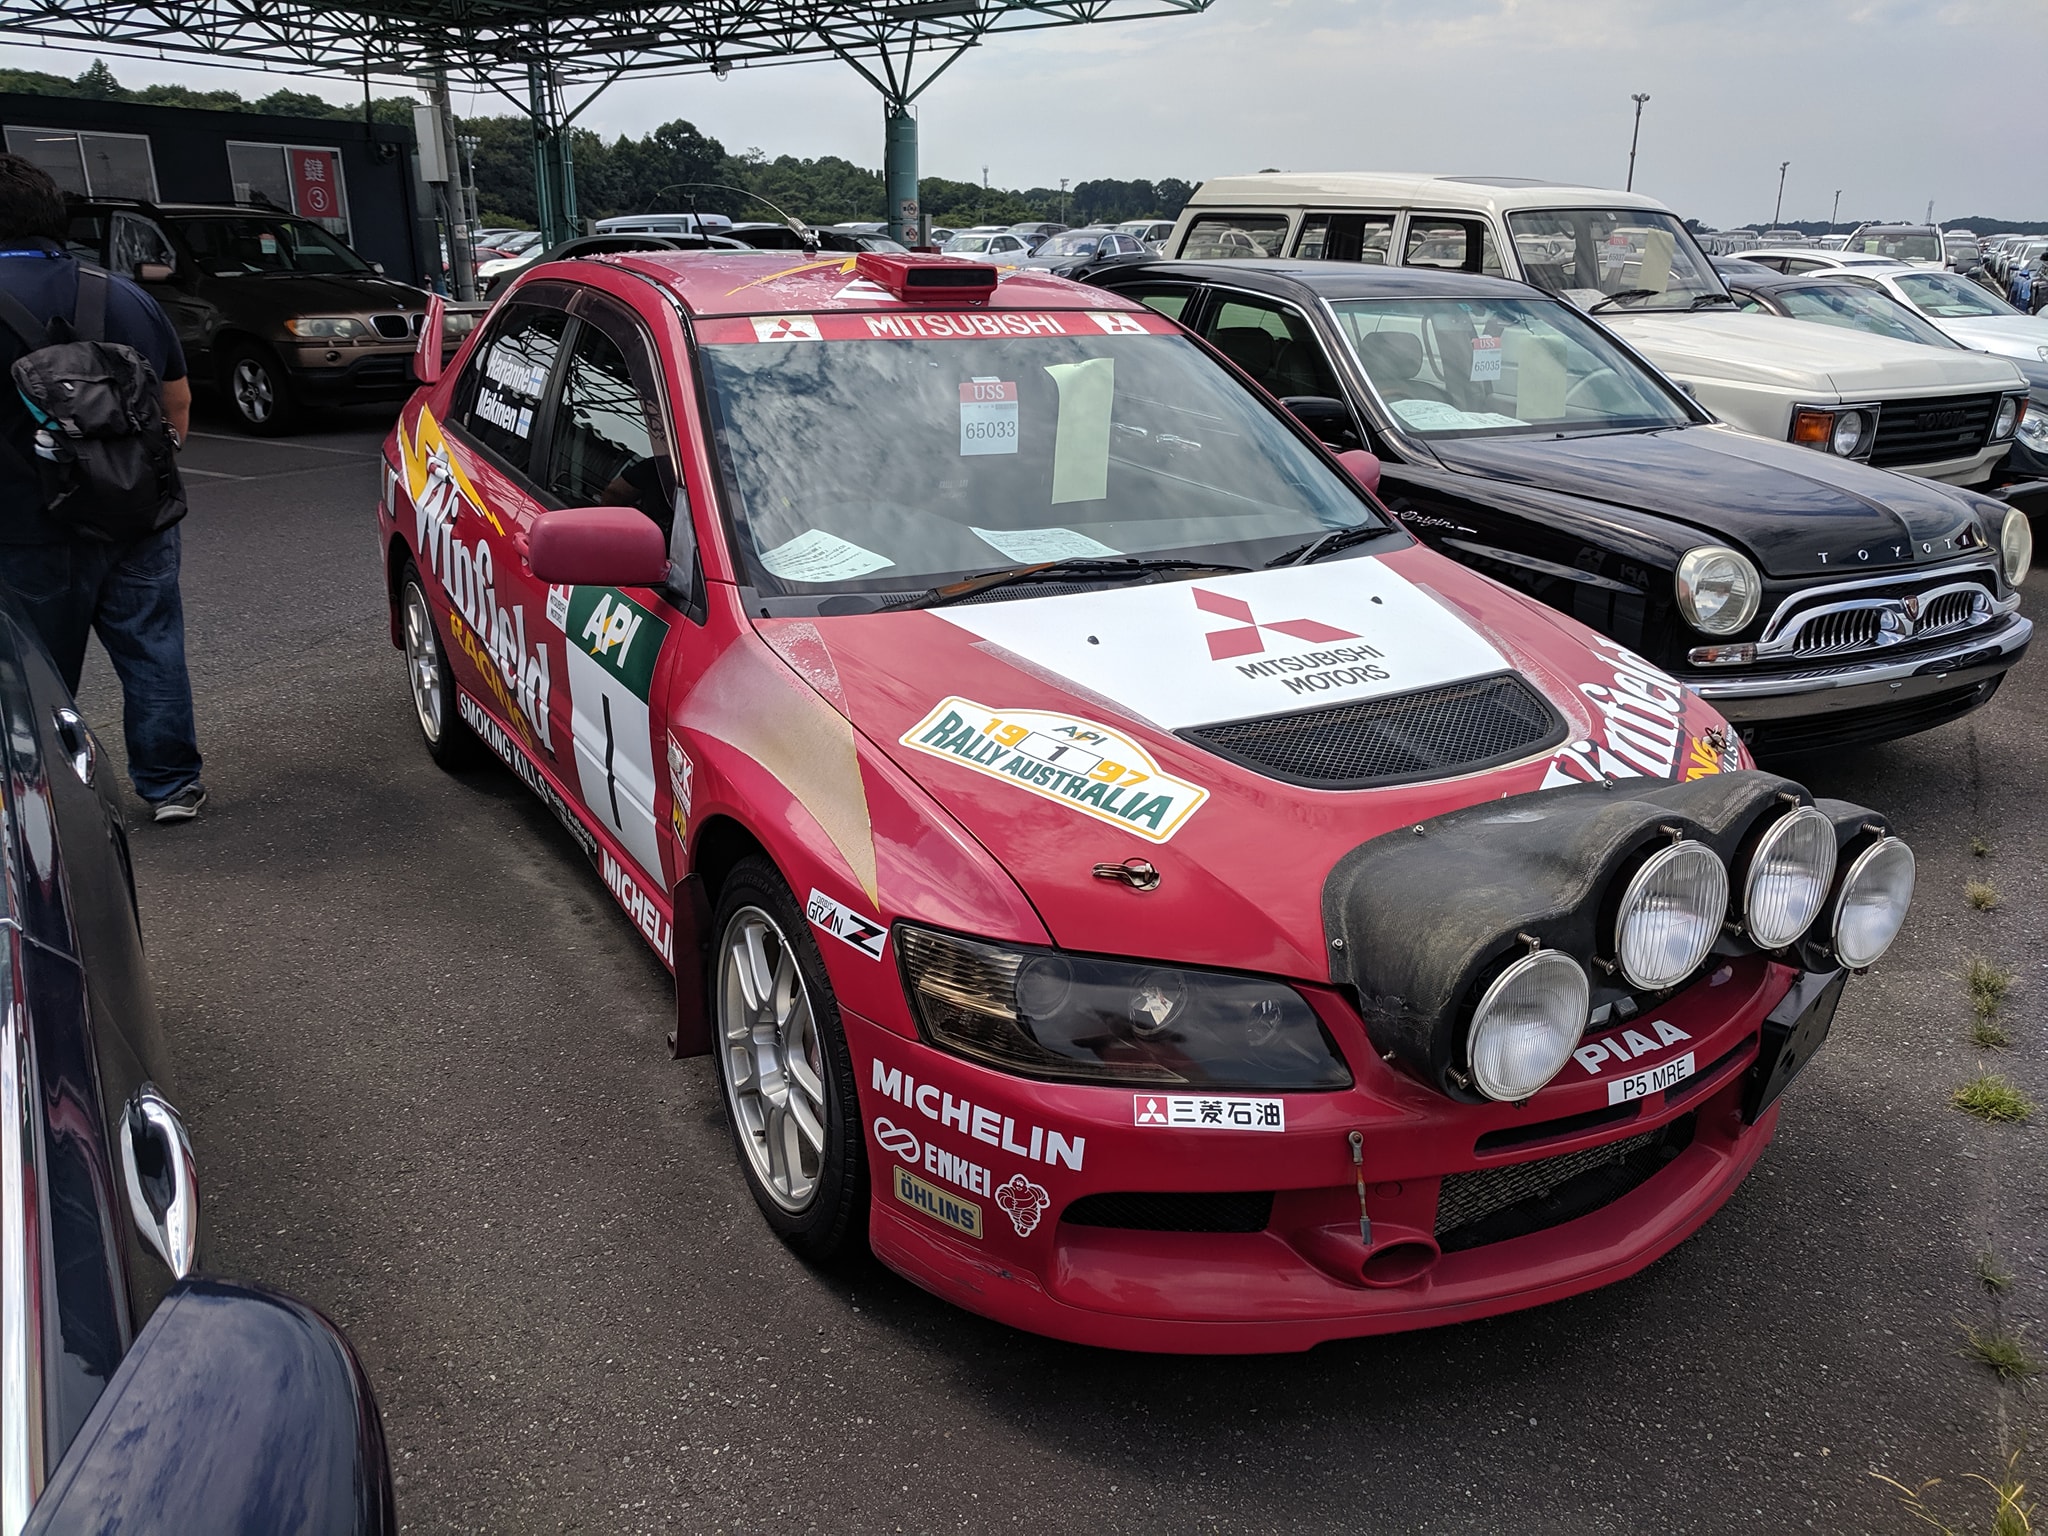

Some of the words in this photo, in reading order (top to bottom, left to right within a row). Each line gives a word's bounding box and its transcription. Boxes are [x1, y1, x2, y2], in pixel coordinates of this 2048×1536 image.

[304, 158, 326, 182] 鍵
[863, 314, 1067, 338] MITSUBISHI
[1480, 338, 1496, 349] USS
[485, 350, 531, 391] Harjanne
[1474, 360, 1500, 372] 65035
[973, 384, 1005, 400] USS
[966, 421, 1016, 440] 65033
[1401, 510, 1455, 528] Origin
[1817, 534, 1970, 564] TOYOTA
[415, 443, 555, 752] Winfield
[581, 592, 643, 669] API
[449, 612, 533, 749] RACING
[1235, 645, 1386, 680] MITSUBISHI
[1280, 664, 1391, 695] MOTORS
[460, 692, 512, 764] SMOKING
[513, 744, 550, 805] KILLS
[982, 718, 1029, 747] 19
[1046, 745, 1070, 762] 1
[1088, 760, 1150, 788] 97
[1051, 725, 1109, 747] API
[919, 710, 1012, 767] RALLY
[999, 755, 1175, 831] AUSTRALIA
[1572, 1019, 1693, 1075] PIAA
[1622, 1075, 1647, 1100] P5
[1652, 1059, 1686, 1091] MRE
[872, 1058, 1086, 1172] MICHELIN
[1173, 1099, 1281, 1127] 三菱石油
[925, 1141, 991, 1199] ENKEI
[900, 1172, 975, 1231] ÖHLINS
